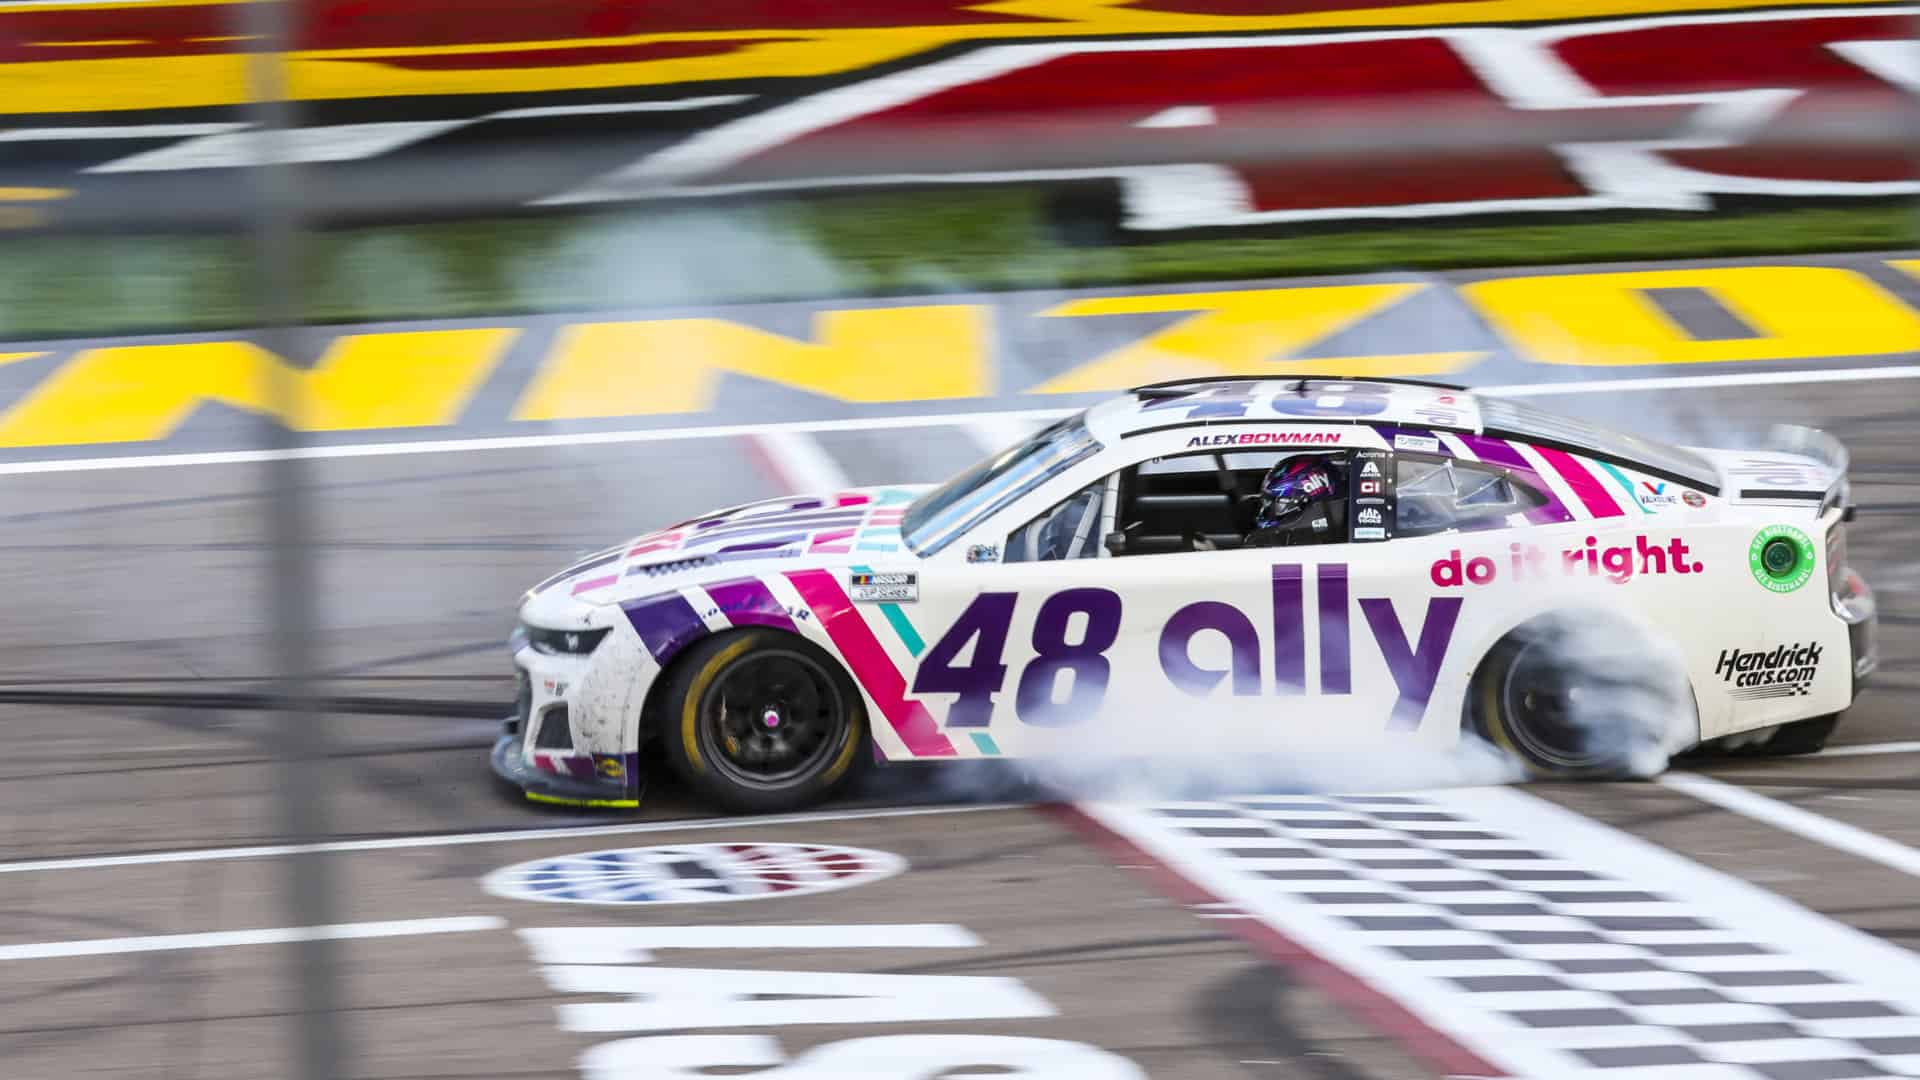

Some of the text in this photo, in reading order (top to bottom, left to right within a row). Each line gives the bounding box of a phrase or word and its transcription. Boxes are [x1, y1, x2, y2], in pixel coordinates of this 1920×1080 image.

[1303, 472, 1330, 494] ally
[1430, 535, 1704, 588] do it right.
[912, 587, 1123, 729] 48
[1158, 563, 1464, 733] ally
[1715, 641, 1823, 681] Hendrick
[1736, 666, 1817, 688] cars.com
